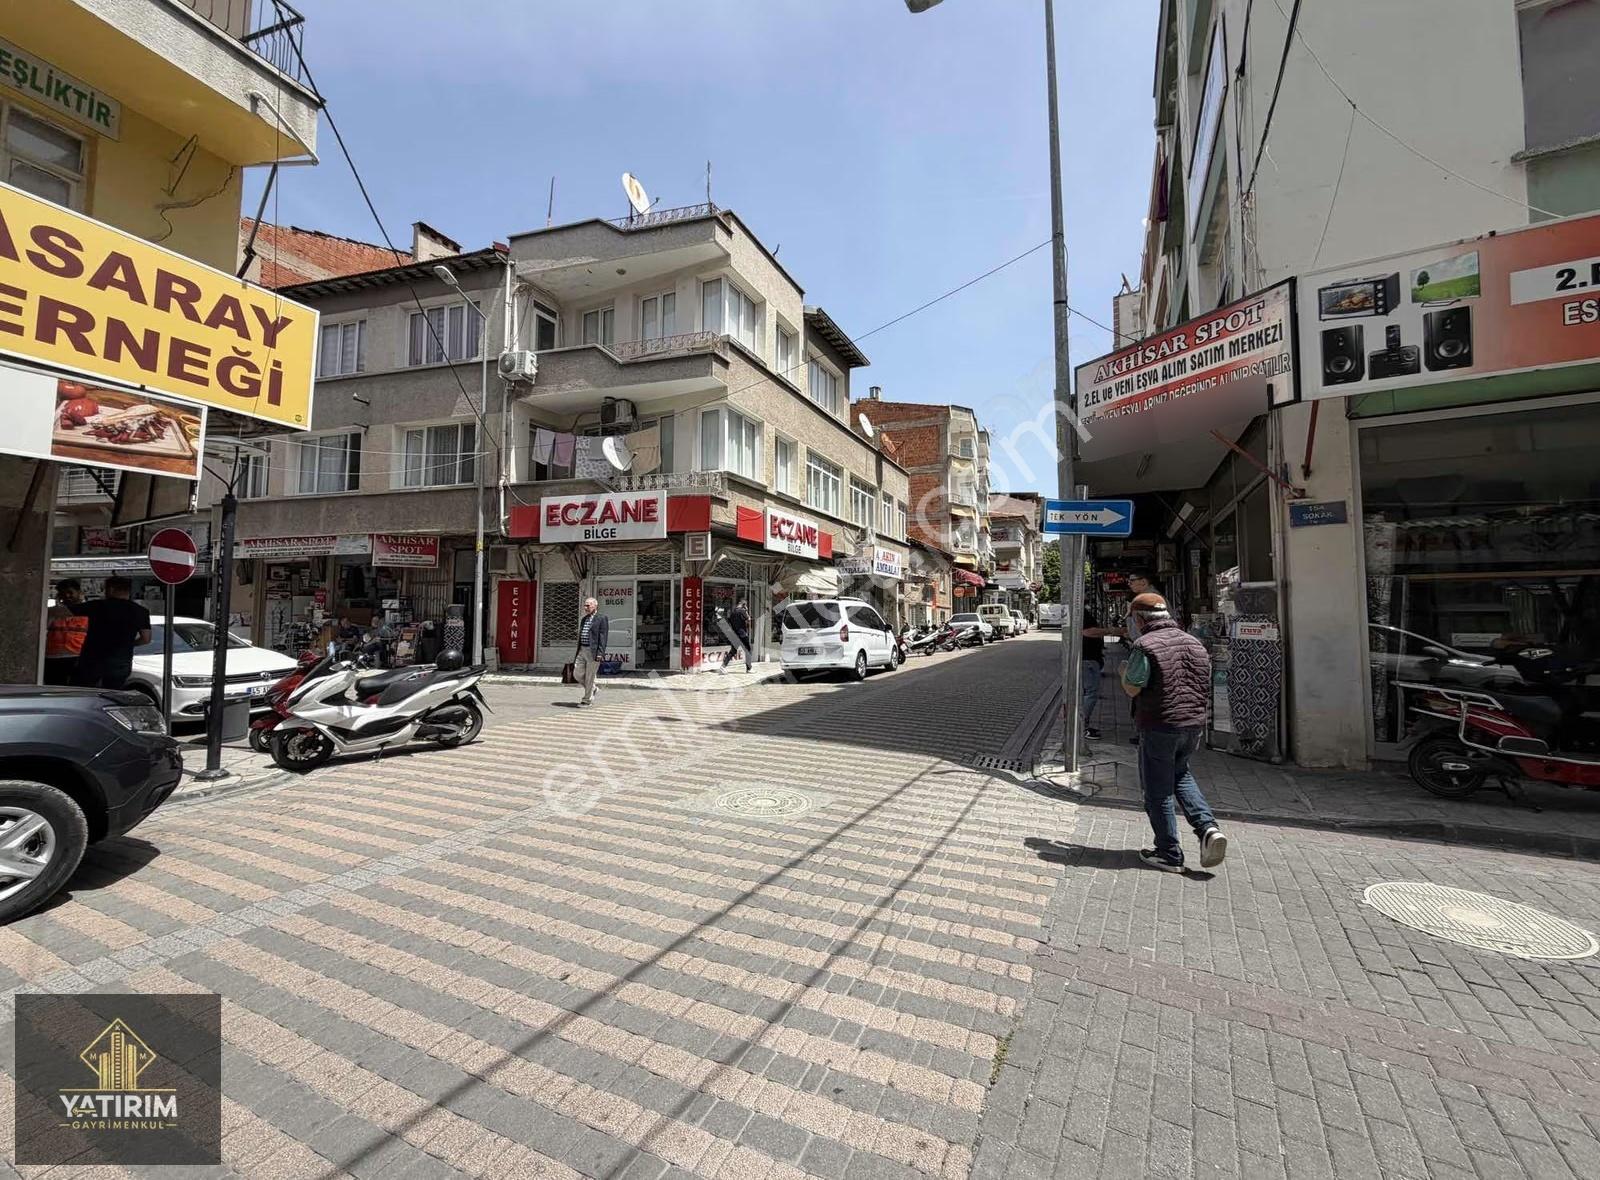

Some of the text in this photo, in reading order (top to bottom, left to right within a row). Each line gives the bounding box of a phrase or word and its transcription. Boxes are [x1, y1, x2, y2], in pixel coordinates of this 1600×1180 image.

[1195, 300, 1264, 345] SPOT
[1084, 391, 1100, 407] 2.EL
[1114, 374, 1134, 396] YENİ
[1136, 370, 1159, 391] EŞYA
[1161, 358, 1187, 380] ALIM
[1190, 344, 1225, 370] SATIM
[1229, 318, 1284, 360] MERKEZİ
[546, 498, 659, 527] ECZANE
[1075, 512, 1098, 521] YÖN
[584, 526, 617, 539] BİLGE
[770, 514, 817, 549] ECZANE
[390, 545, 423, 554] SPOT
[598, 588, 634, 597] ECZANE
[510, 587, 519, 649] ECZANE
[684, 588, 693, 656] ECZANE
